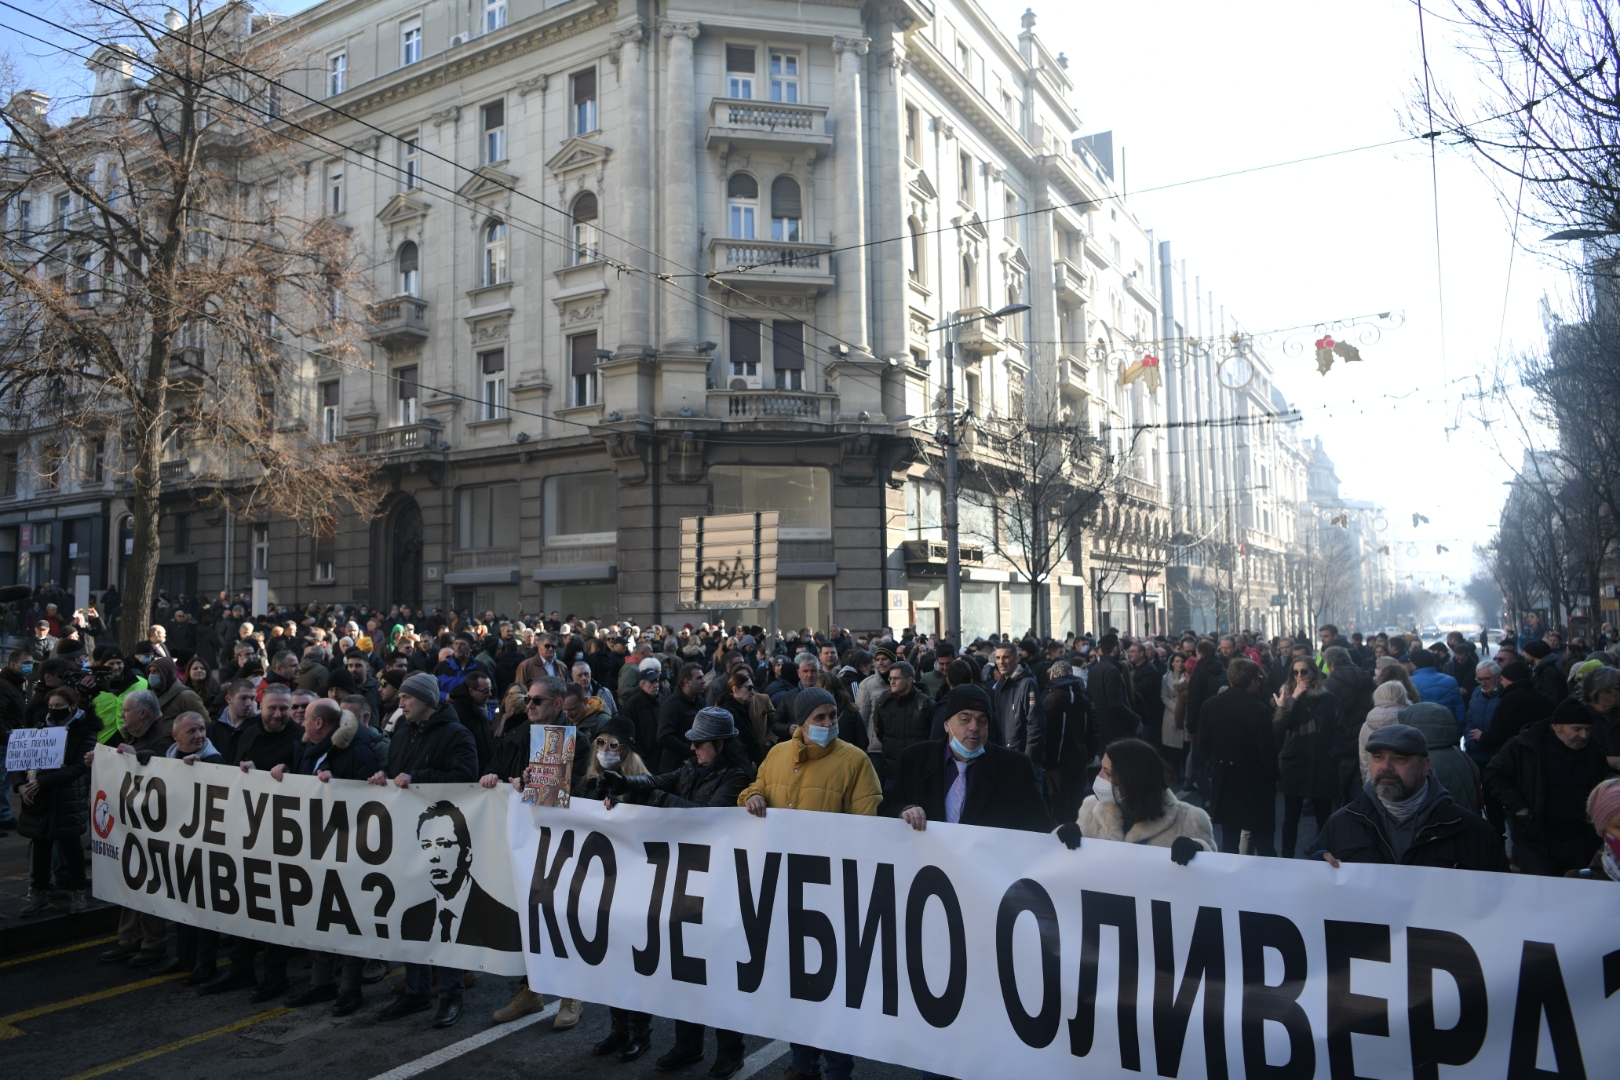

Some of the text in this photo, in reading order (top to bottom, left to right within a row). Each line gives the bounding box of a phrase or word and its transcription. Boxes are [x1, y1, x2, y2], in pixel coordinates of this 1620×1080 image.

[14, 731, 26, 739] ДА
[119, 771, 393, 866] КО ЈЕ УБИО
[121, 831, 396, 940] ОЛИВЕРА?
[528, 825, 1620, 1080] КО ЈЕ УБИО ОЛИВЕРА
